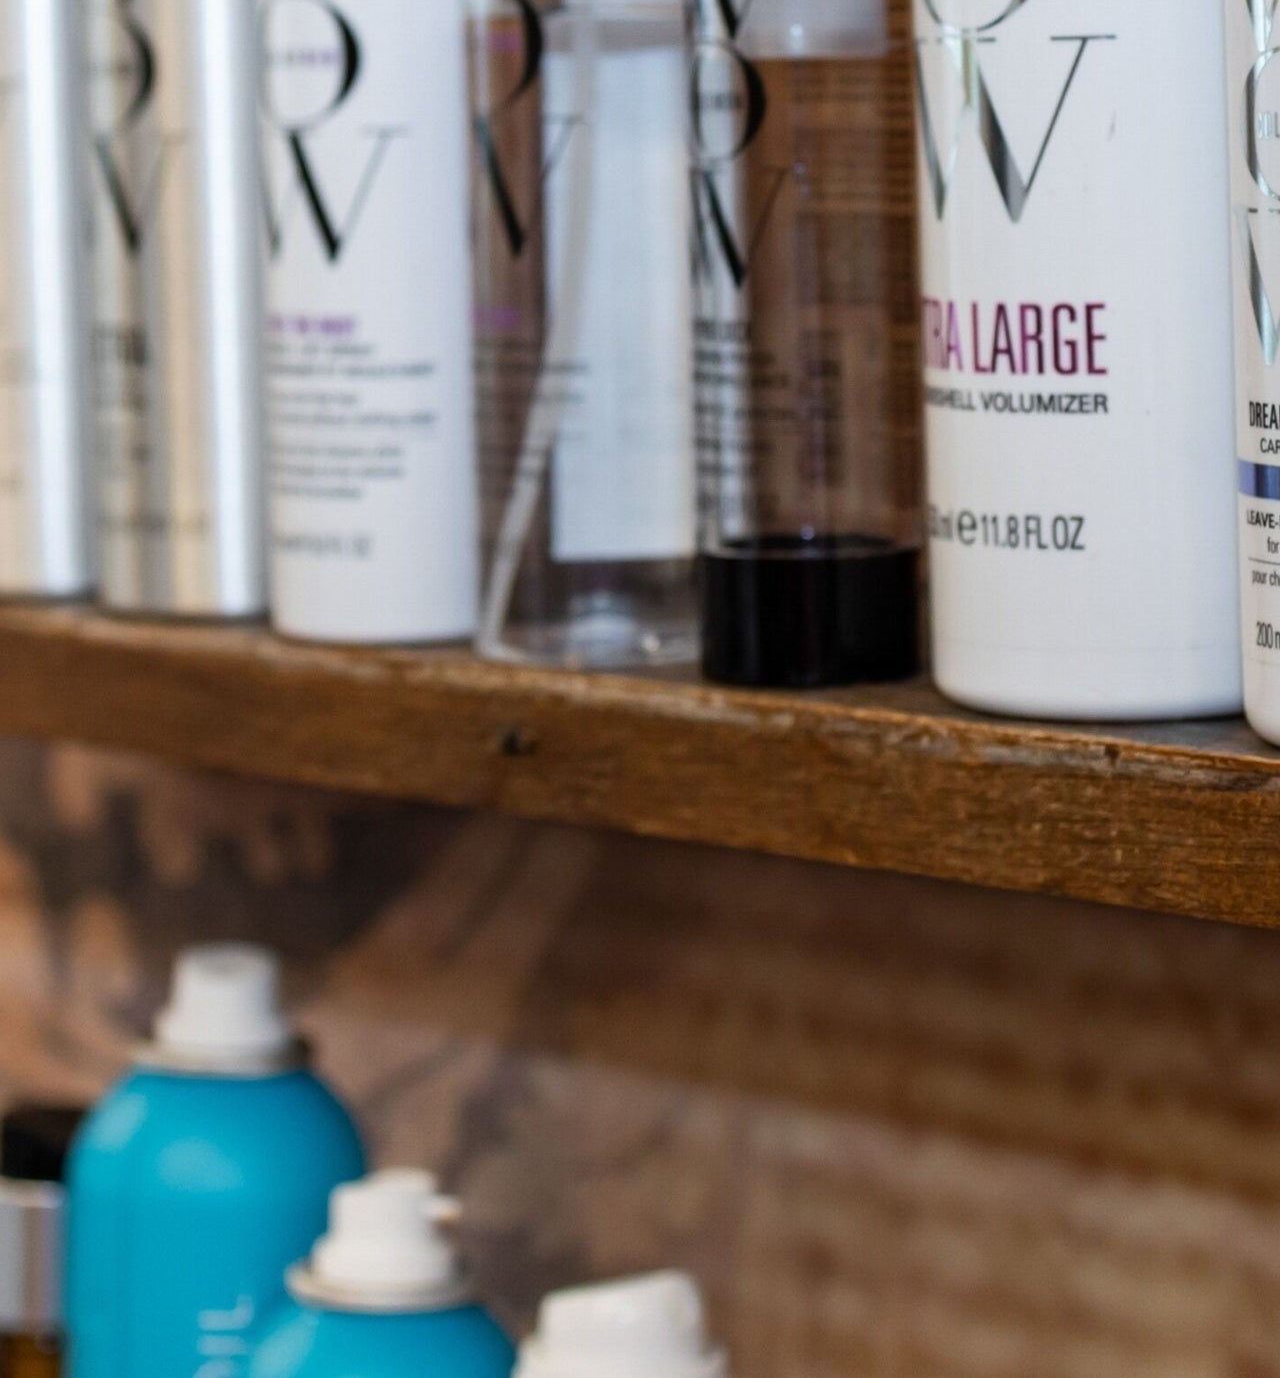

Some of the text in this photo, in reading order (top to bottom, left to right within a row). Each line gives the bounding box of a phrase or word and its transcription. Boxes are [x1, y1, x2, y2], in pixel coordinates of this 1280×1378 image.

[972, 301, 1109, 376] LARGE
[981, 391, 1109, 415] VOLUMIZER
[982, 513, 1020, 550] 11.8
[1024, 514, 1048, 551] FL
[1052, 515, 1086, 552] OZ
[1267, 536, 1280, 554] for
